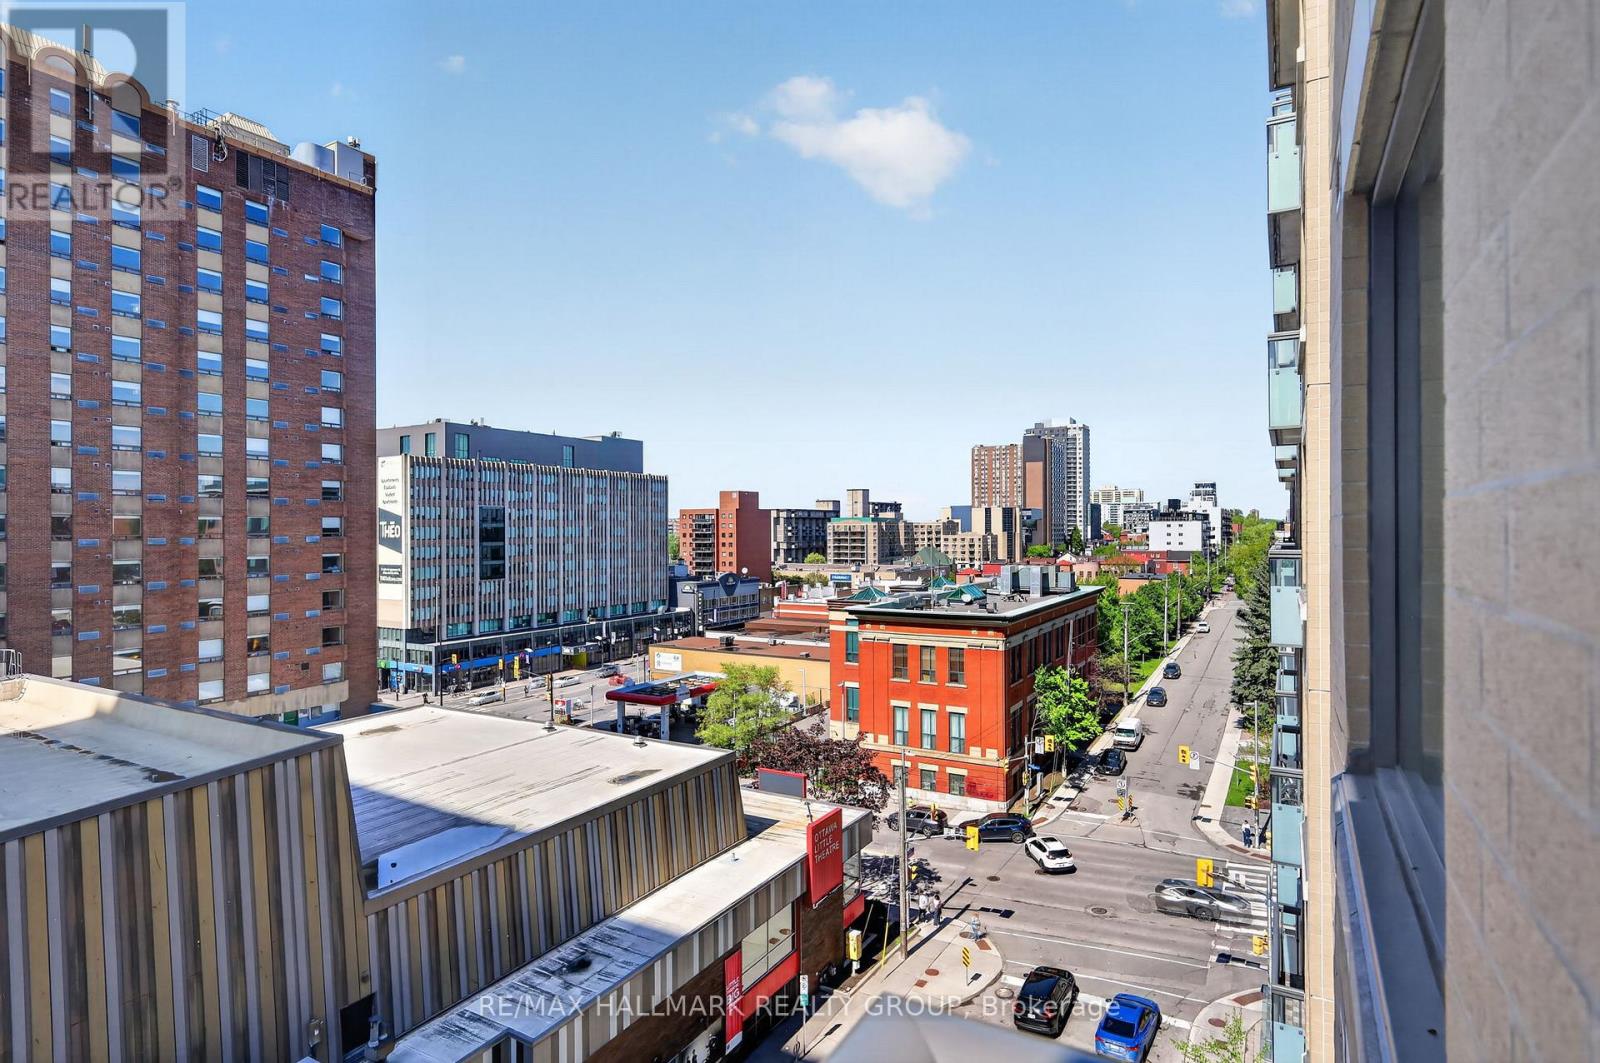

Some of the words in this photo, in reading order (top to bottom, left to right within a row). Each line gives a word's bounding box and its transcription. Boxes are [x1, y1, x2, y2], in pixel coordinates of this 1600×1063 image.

[814, 822, 838, 842] OTTAWA
[814, 834, 833, 854] LITTLE
[814, 841, 840, 864] THEATRE
